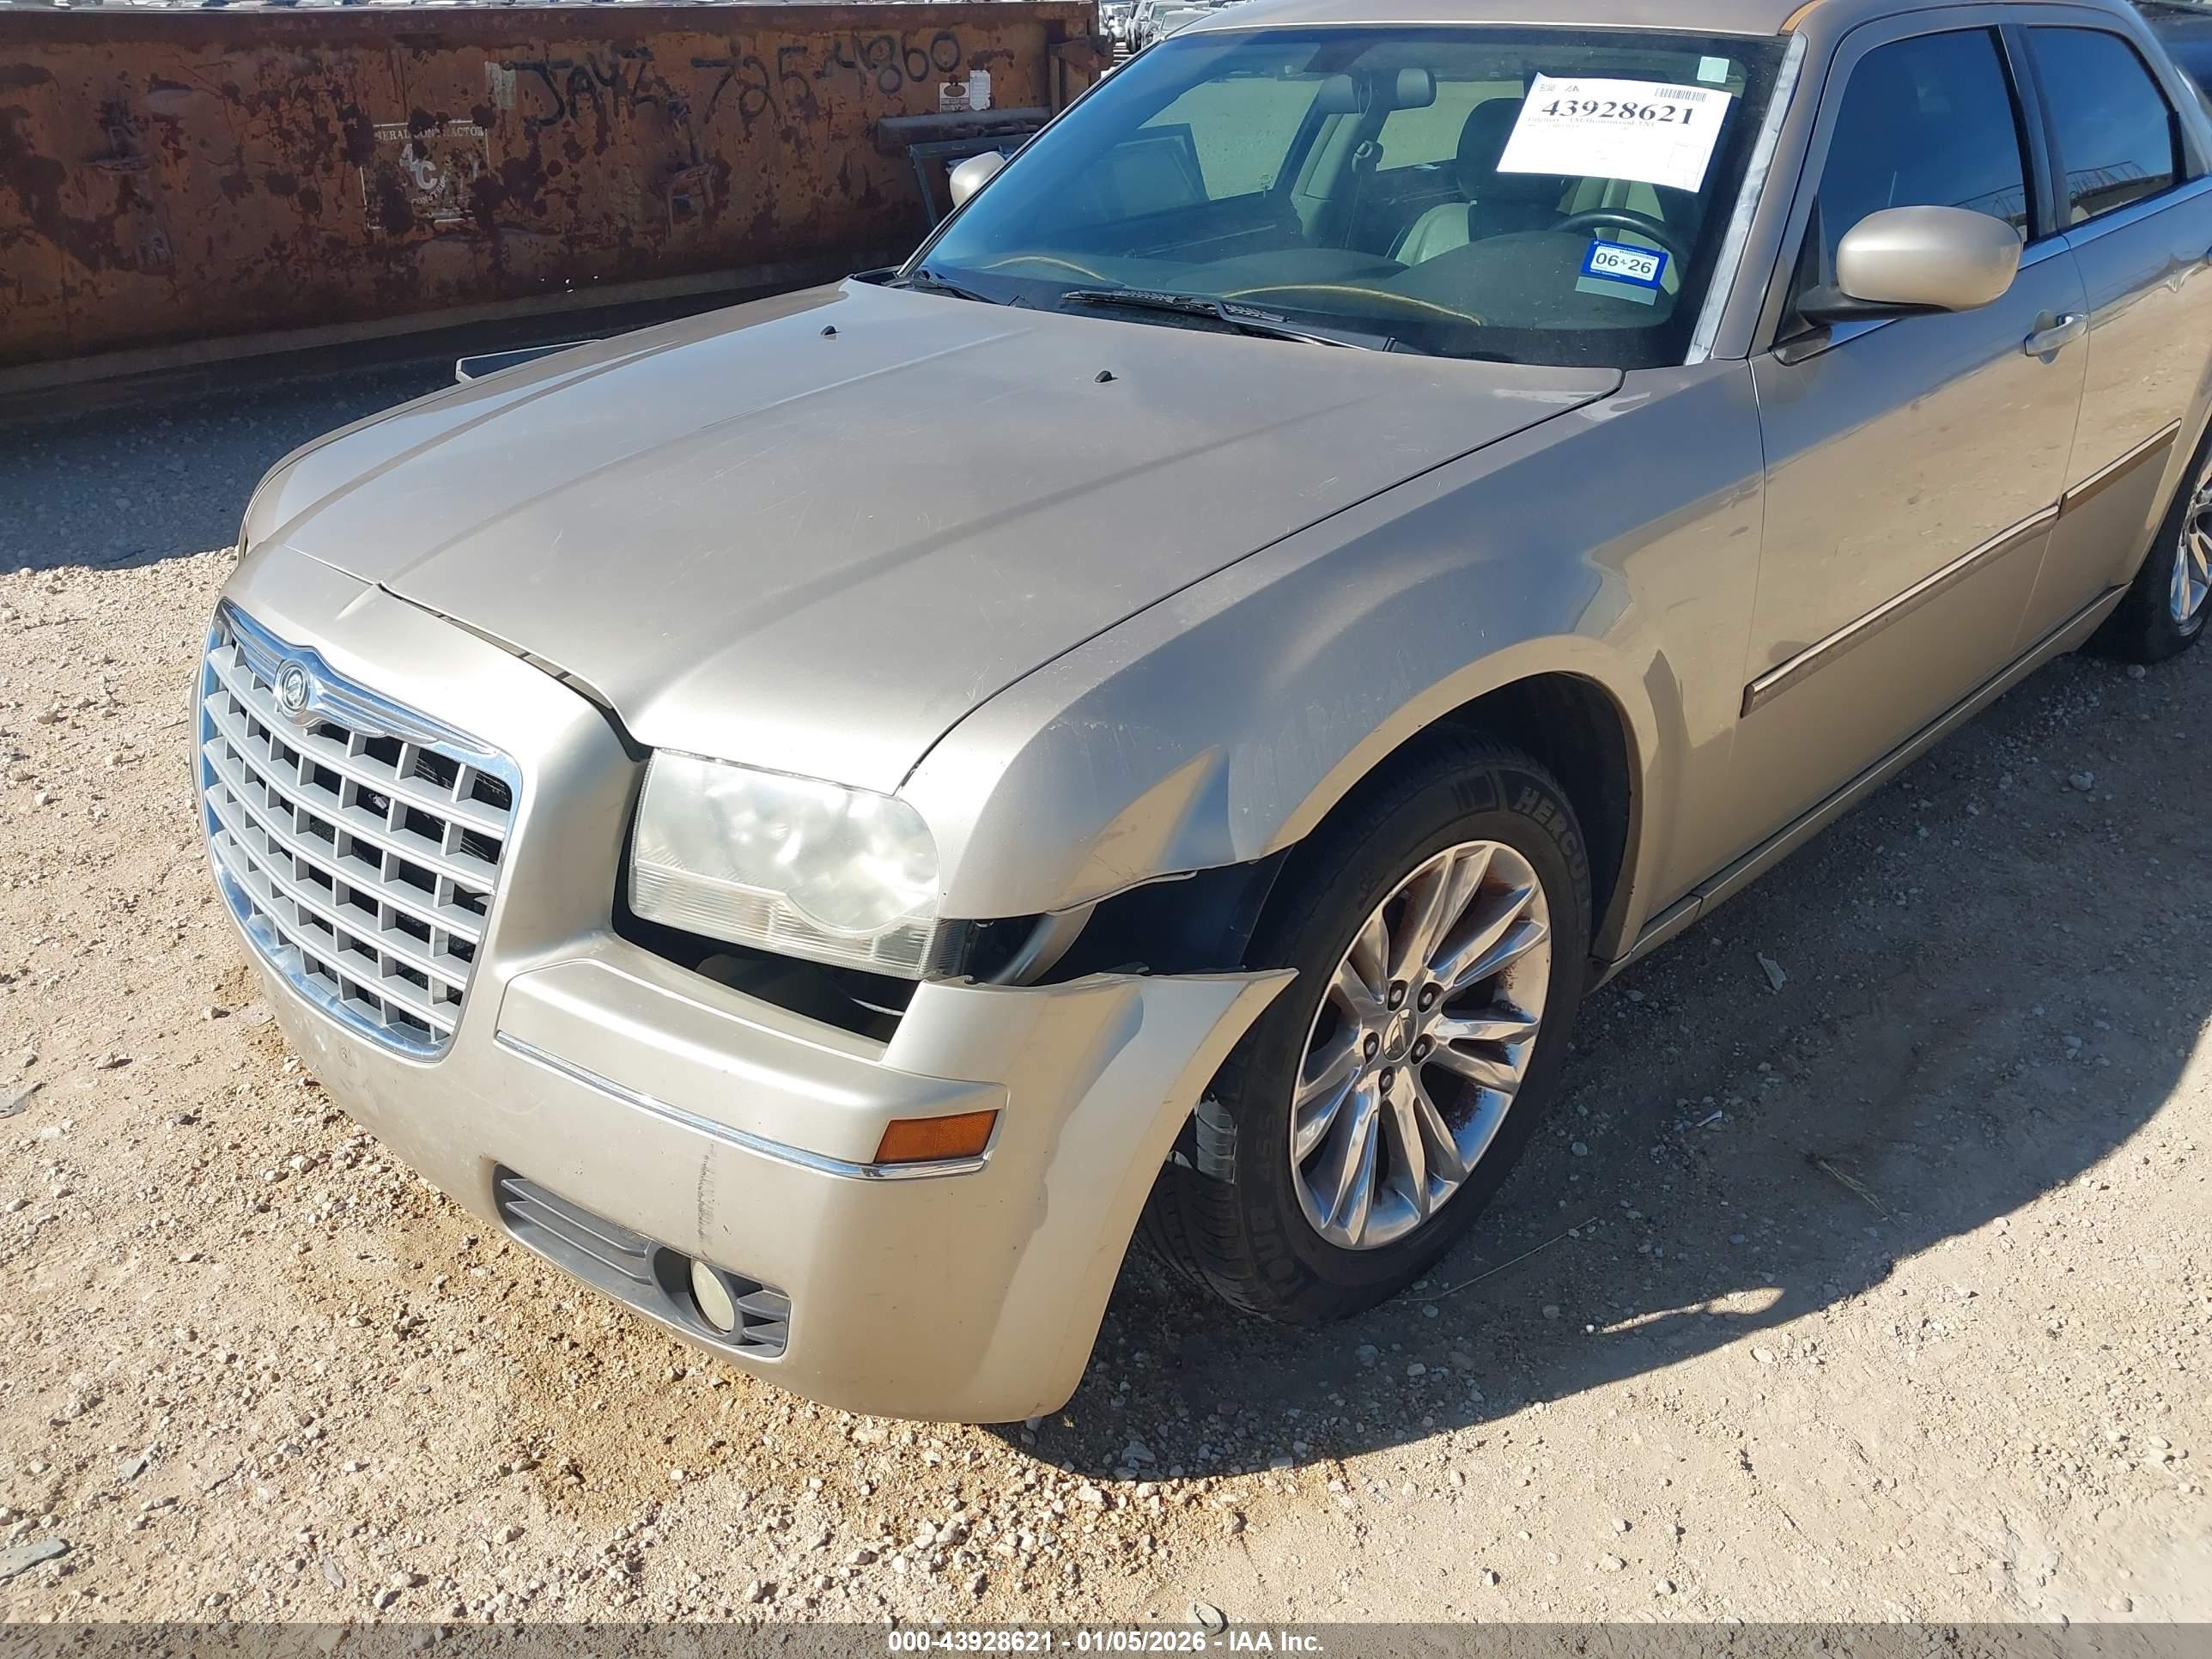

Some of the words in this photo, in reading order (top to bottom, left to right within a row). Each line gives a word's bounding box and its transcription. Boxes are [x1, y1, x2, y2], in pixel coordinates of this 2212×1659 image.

[1540, 99, 1694, 125] 43928621
[1595, 252, 1620, 267] 06
[1628, 258, 1653, 274] 26
